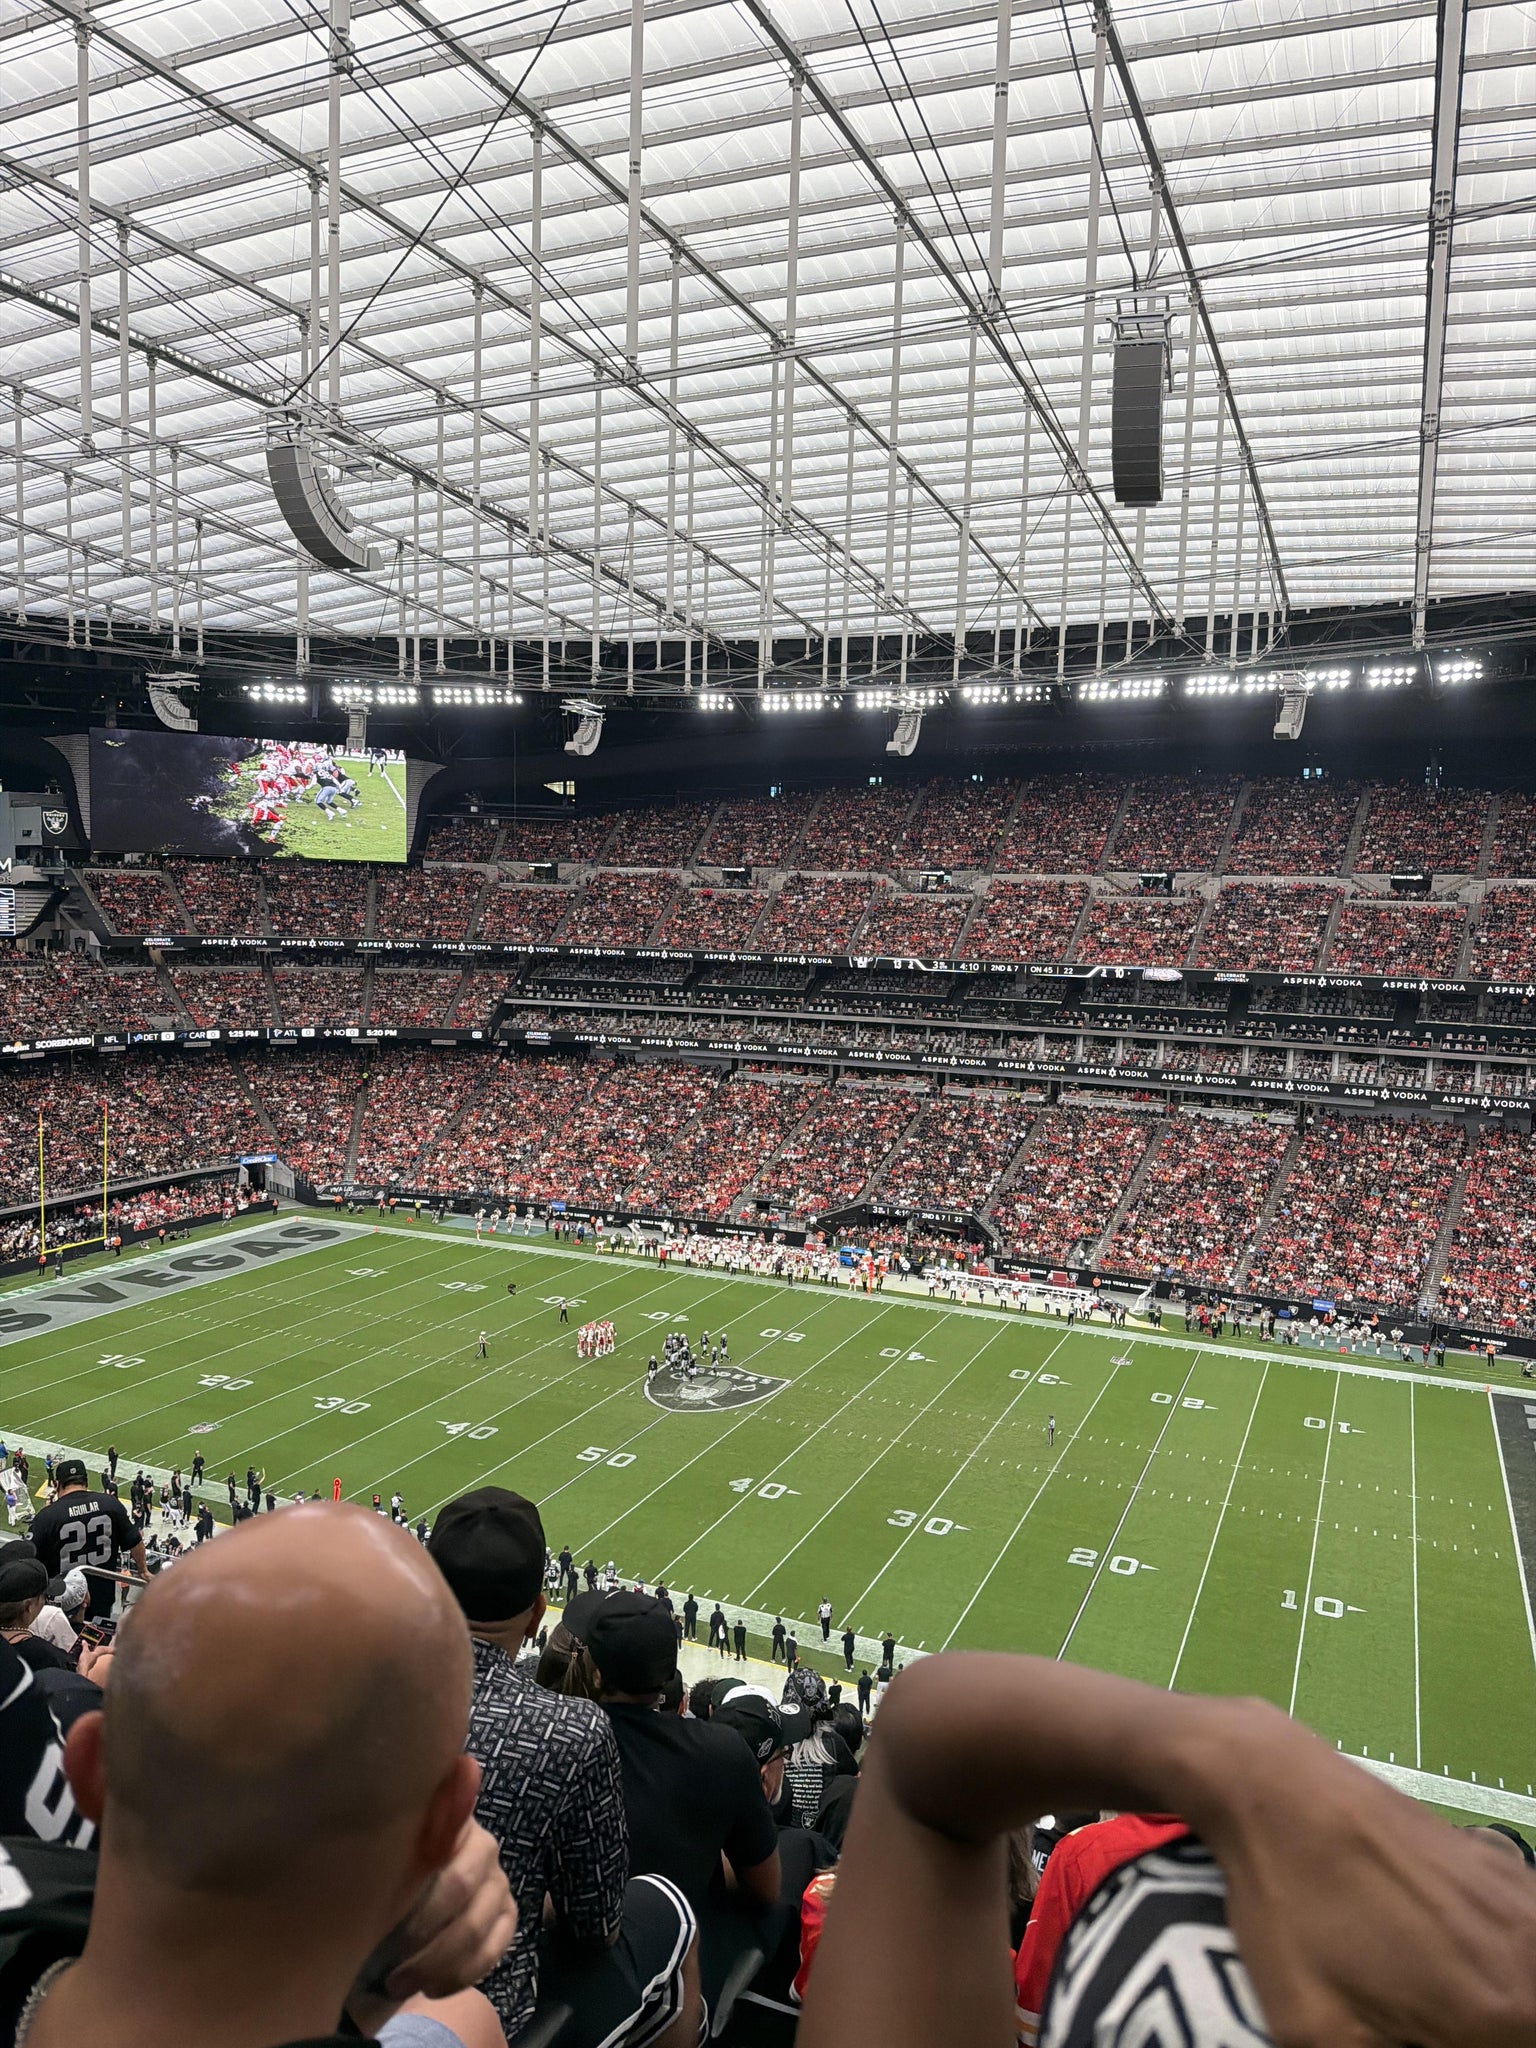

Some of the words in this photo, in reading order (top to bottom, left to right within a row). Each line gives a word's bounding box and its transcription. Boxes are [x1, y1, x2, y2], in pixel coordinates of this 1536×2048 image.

[959, 963, 979, 971] 4:10
[991, 964, 1005, 972] 2ND
[1063, 967, 1074, 975] 22
[1382, 981, 1417, 989] ASPEN
[1431, 983, 1466, 991] VODKA
[1487, 986, 1523, 994] ASPEN
[143, 1033, 159, 1041] DET
[2, 1041, 30, 1053] allegiant
[35, 1037, 92, 1049] SCOREBOARD
[960, 1058, 987, 1066] VODKA
[998, 1061, 1025, 1069] ASPEN
[1037, 1063, 1065, 1071] VODKA
[1078, 1067, 1107, 1075] ASPEN
[1119, 1070, 1148, 1078] VODKA
[1161, 1073, 1192, 1081] ASPEN
[1205, 1076, 1237, 1085] VODKA
[1250, 1080, 1283, 1088] ASPEN
[1297, 1084, 1330, 1092] VODKA
[1344, 1088, 1378, 1096] ASPEN
[1393, 1091, 1427, 1100] VODKA
[1442, 1096, 1478, 1105] ASPEN
[1494, 1100, 1530, 1109] VODKA
[39, 1225, 341, 1304] VEGAS
[68, 1501, 100, 1517] AGUILAR
[60, 1514, 113, 1574] 23
